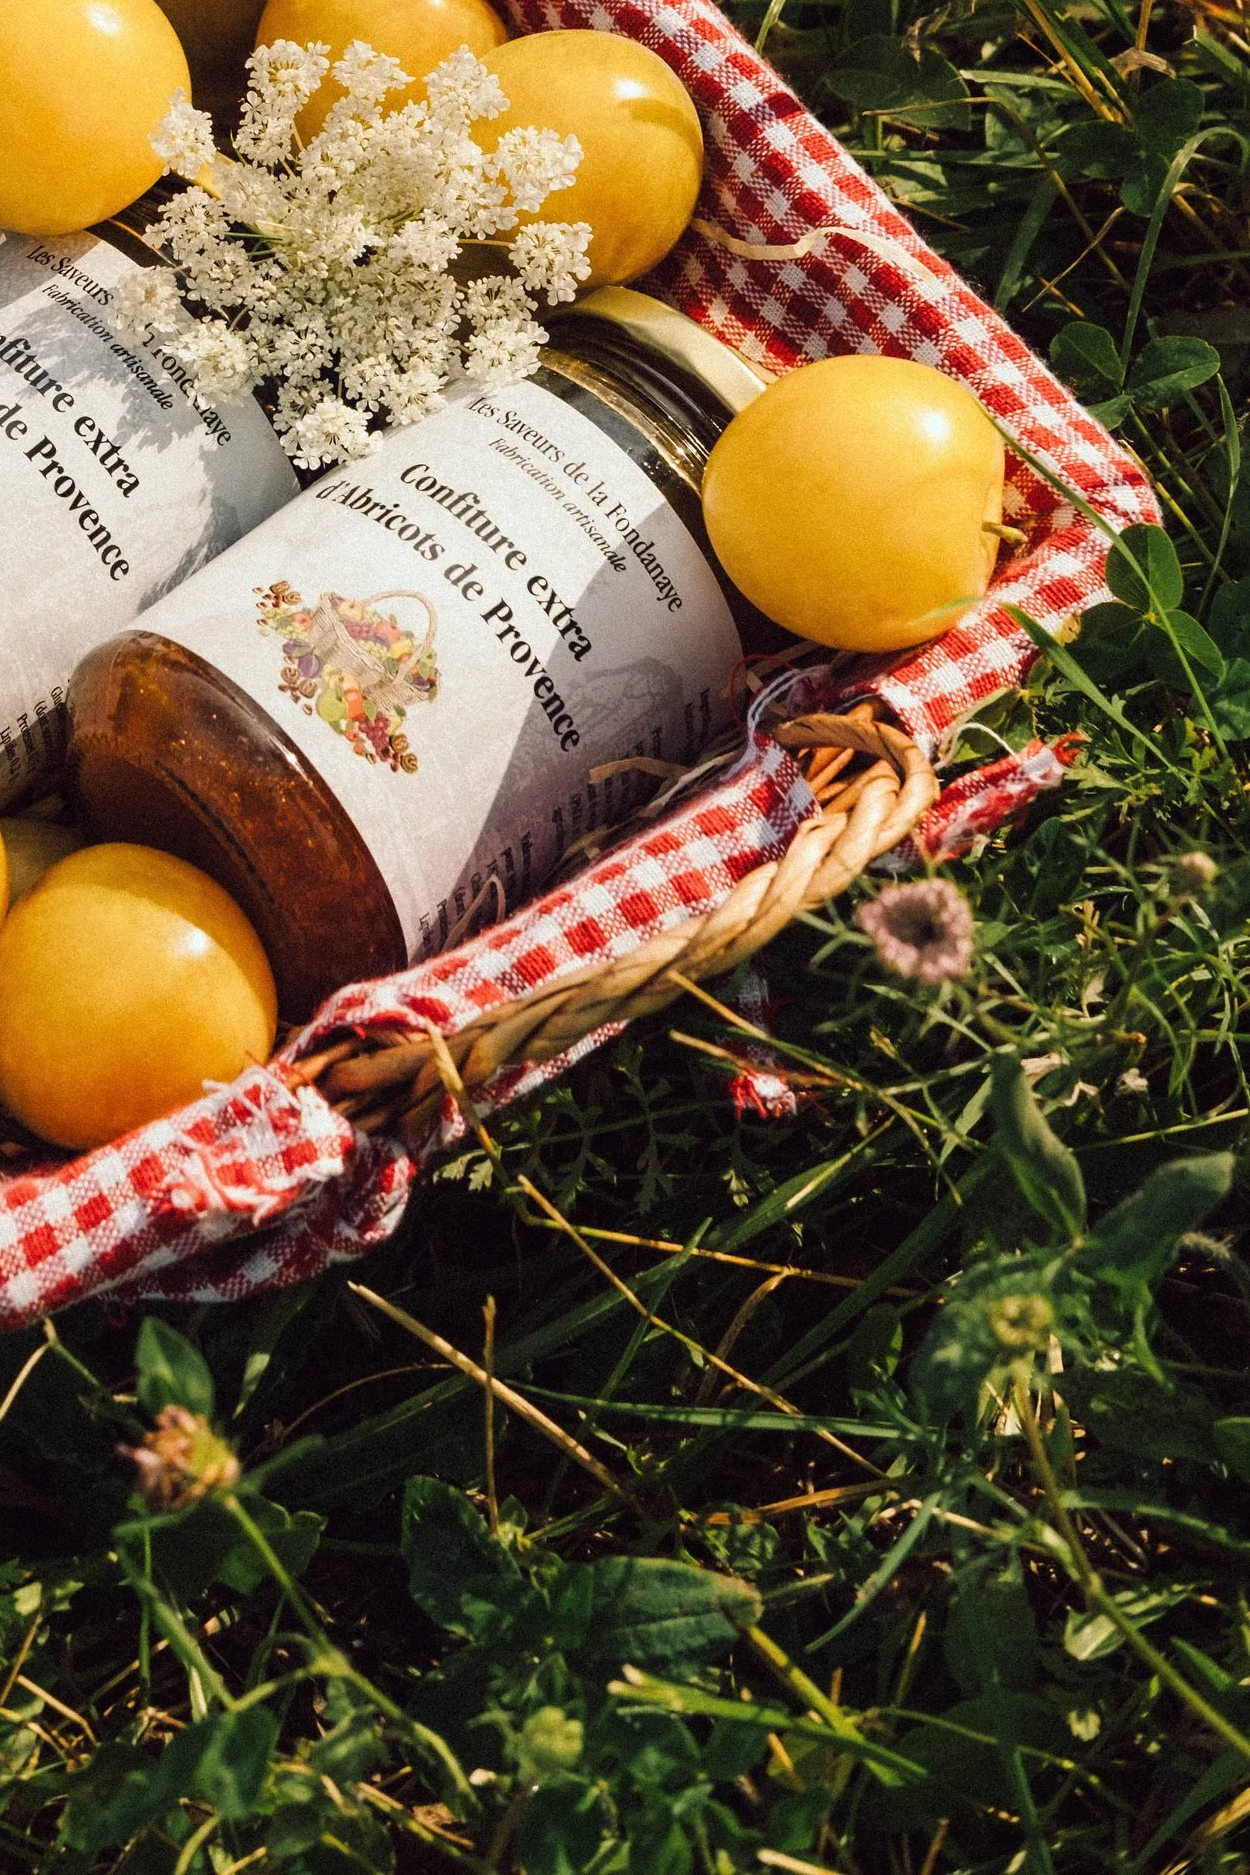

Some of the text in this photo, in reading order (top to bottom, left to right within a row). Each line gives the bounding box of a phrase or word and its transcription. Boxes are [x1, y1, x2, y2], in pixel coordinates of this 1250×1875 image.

[26, 244, 52, 267] Les
[50, 257, 115, 306] Saveurs
[42, 284, 173, 410] Fabrication artisanale
[23, 435, 130, 581] Provence
[74, 415, 141, 498] extra
[467, 396, 683, 613] Les Saveurs de la Fondanaye
[487, 437, 627, 573] Fabrication artisanale
[316, 480, 581, 753] d'Abricots de Provence
[399, 462, 593, 663] Confiture extra
